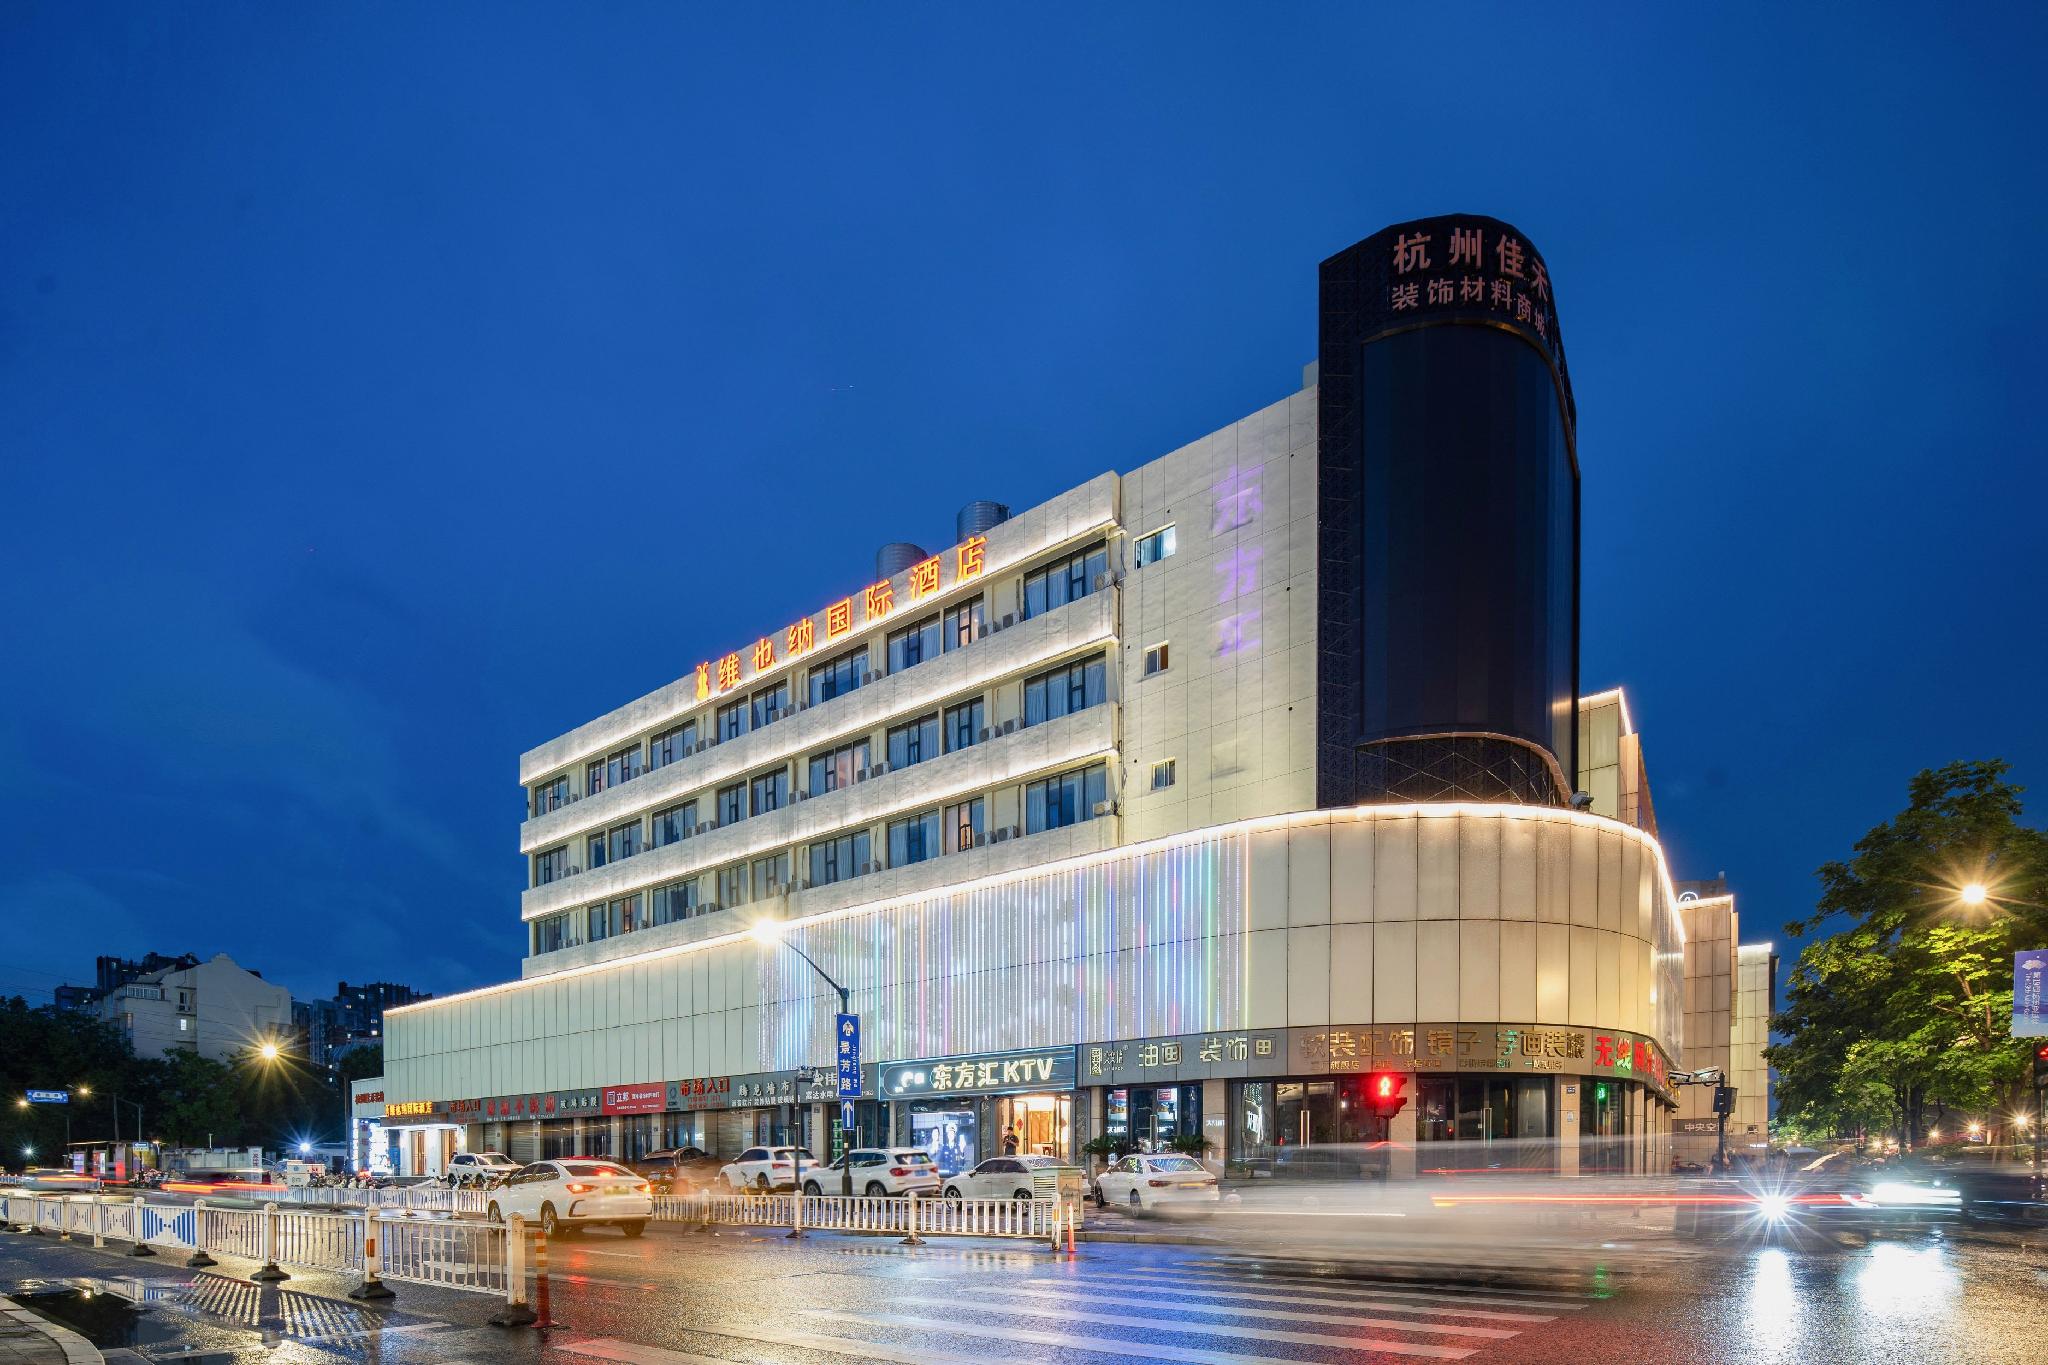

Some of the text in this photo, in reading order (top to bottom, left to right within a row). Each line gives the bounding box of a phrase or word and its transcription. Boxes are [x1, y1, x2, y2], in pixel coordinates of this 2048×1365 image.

[1393, 228, 1548, 303] 杭州佳禾
[1391, 275, 1546, 340] 装饰材料商城
[718, 536, 988, 692] 维也纳国际酒店
[1138, 1041, 1182, 1067] 油画
[1199, 1034, 1277, 1062] 装饰画
[1301, 1030, 1414, 1058] 软装配饰
[1427, 1029, 1481, 1057] 镜子
[840, 1040, 852, 1091] 景芳路
[681, 1078, 730, 1096] 市场入口
